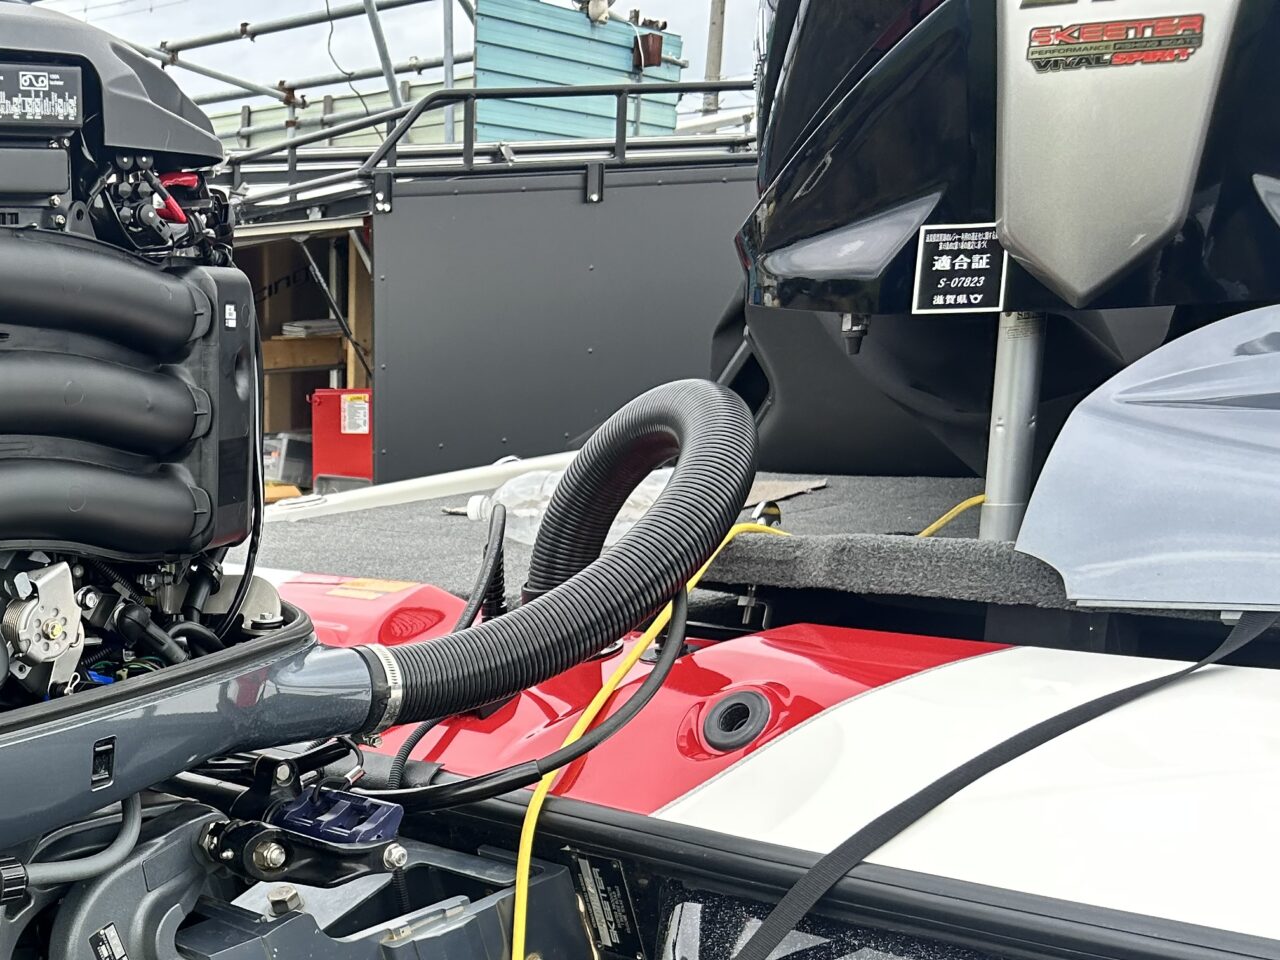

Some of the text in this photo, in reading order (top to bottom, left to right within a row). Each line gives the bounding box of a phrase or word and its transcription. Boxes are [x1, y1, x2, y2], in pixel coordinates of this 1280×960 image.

[1031, 15, 1203, 45] SKEETER
[1030, 43, 1113, 57] PERFORMANCE
[932, 253, 991, 271] 適合証
[937, 276, 985, 288] S-07823
[933, 294, 968, 305] 滋賀県
